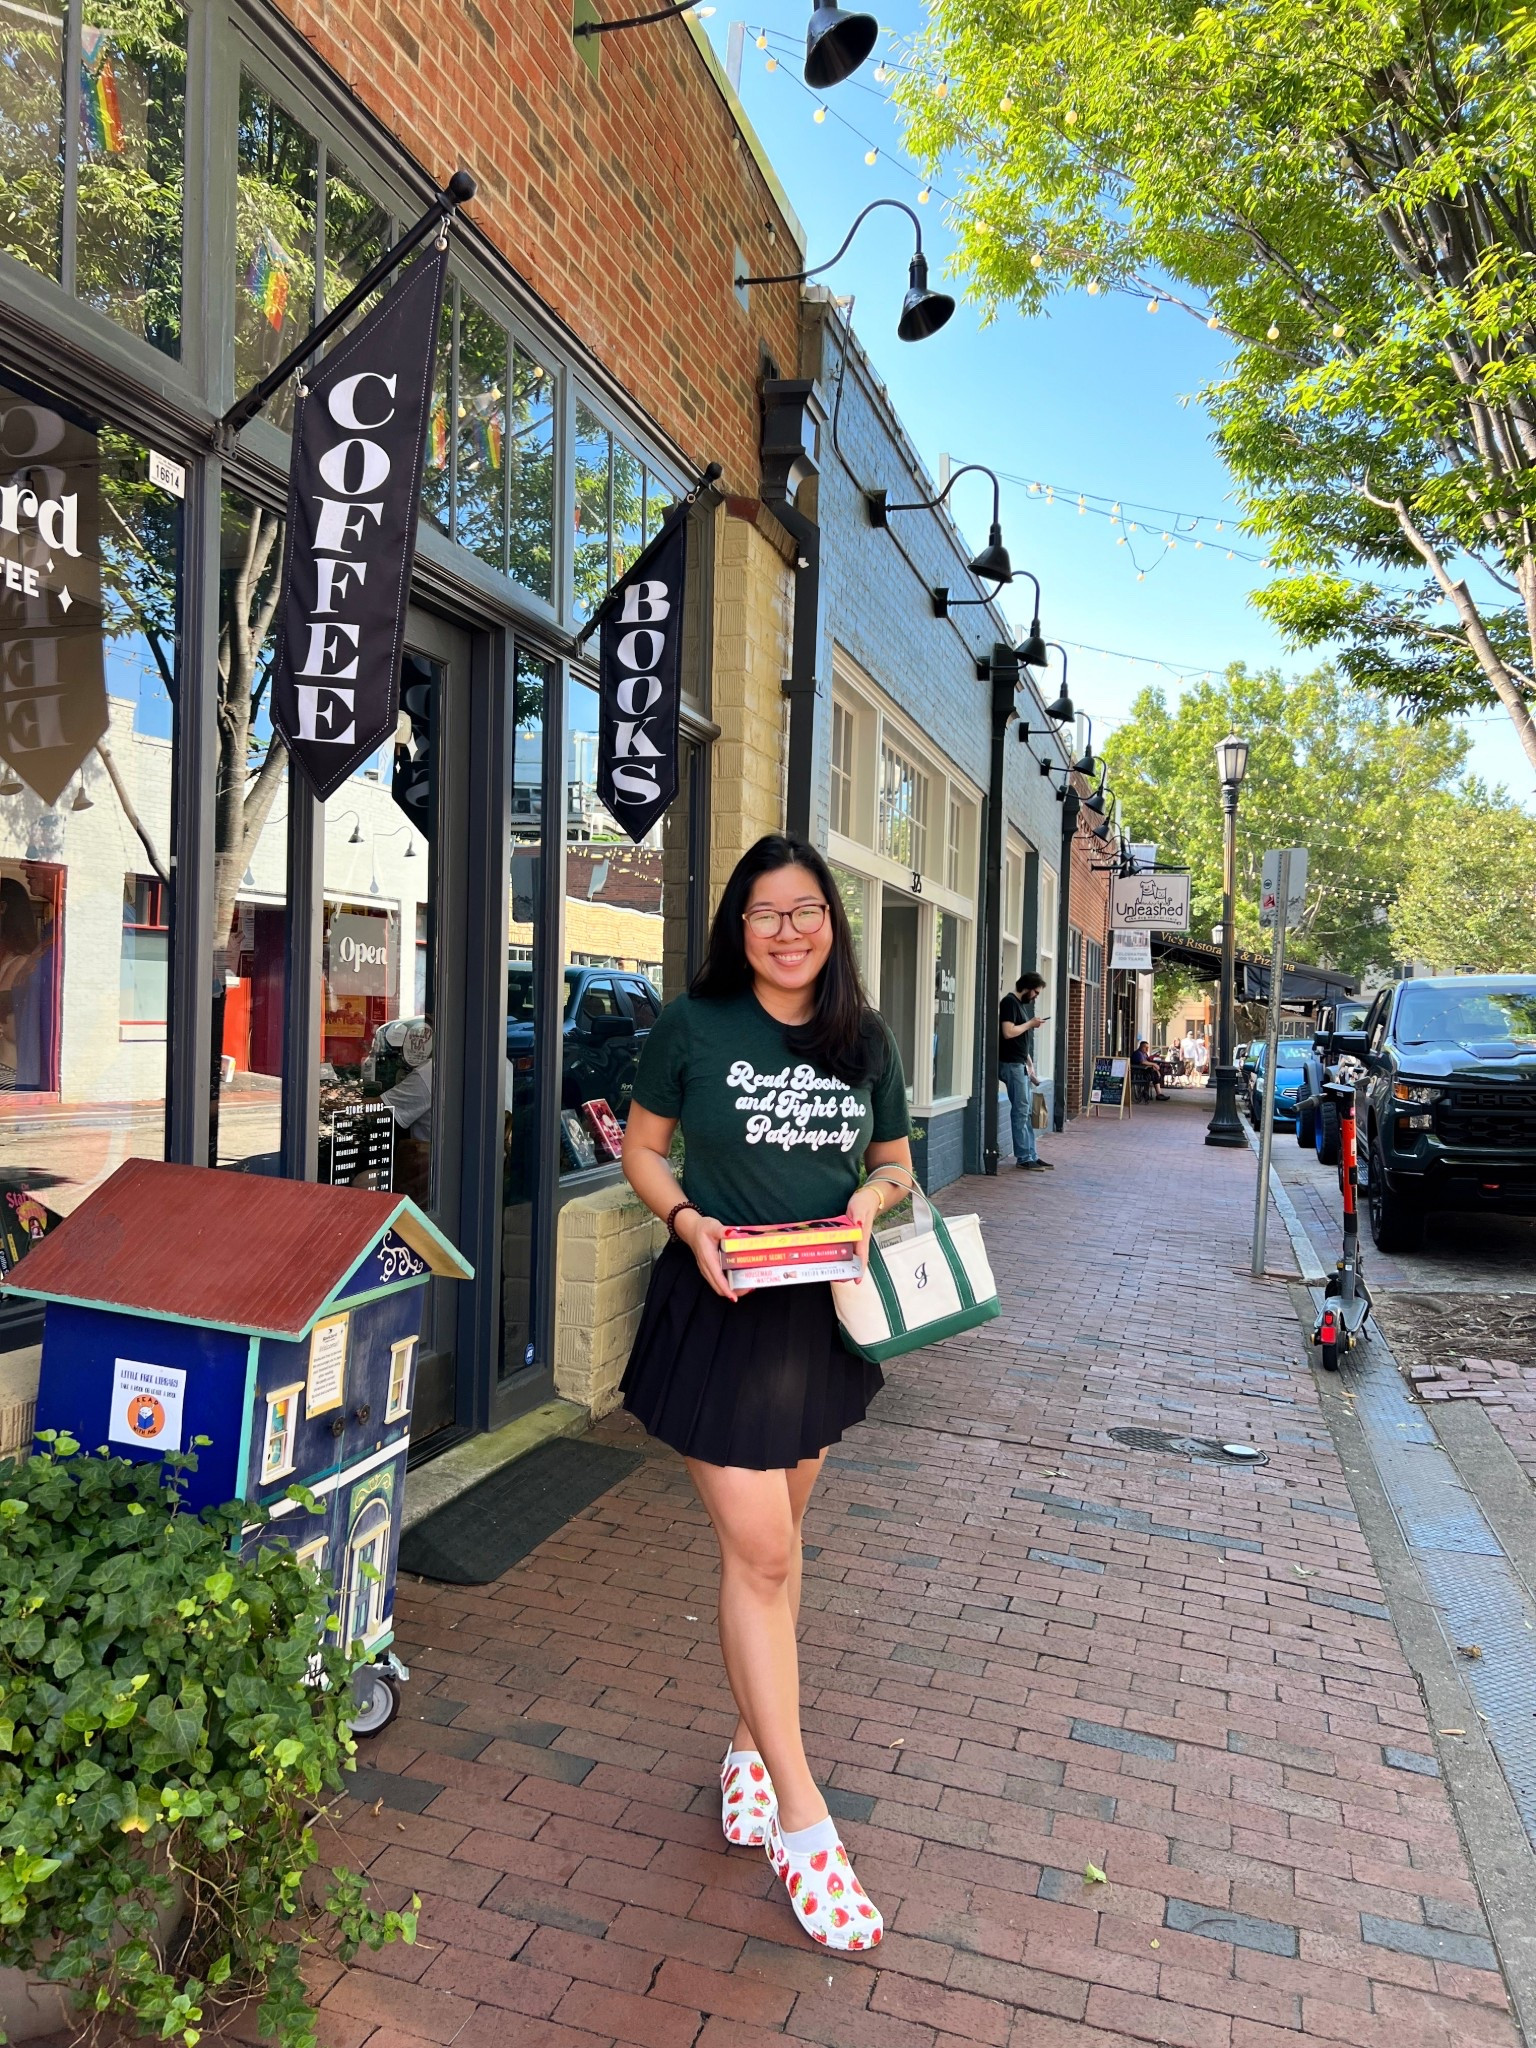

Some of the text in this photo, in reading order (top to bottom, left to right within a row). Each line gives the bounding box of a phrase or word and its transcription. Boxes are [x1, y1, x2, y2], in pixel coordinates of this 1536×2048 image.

[156, 465, 179, 488] 16614
[0, 484, 82, 558] rd
[293, 373, 397, 745] COFFEE
[614, 580, 669, 806] BOOKS
[1116, 902, 1183, 917] Unleashed
[340, 936, 388, 972] Open
[1160, 931, 1184, 945] Vic's
[1185, 938, 1238, 958] Ristorae
[1240, 951, 1251, 961] &
[726, 1061, 790, 1093] Read
[345, 1103, 384, 1115] STORE HOURS
[735, 1090, 866, 1126] and Fight the
[745, 1114, 860, 1152] Patriarchy
[768, 1253, 787, 1261] SECRET
[120, 1370, 138, 1380] LITTLE
[140, 1373, 153, 1383] FREE
[136, 1397, 159, 1405] READ
[133, 1425, 157, 1435] WITH ME
